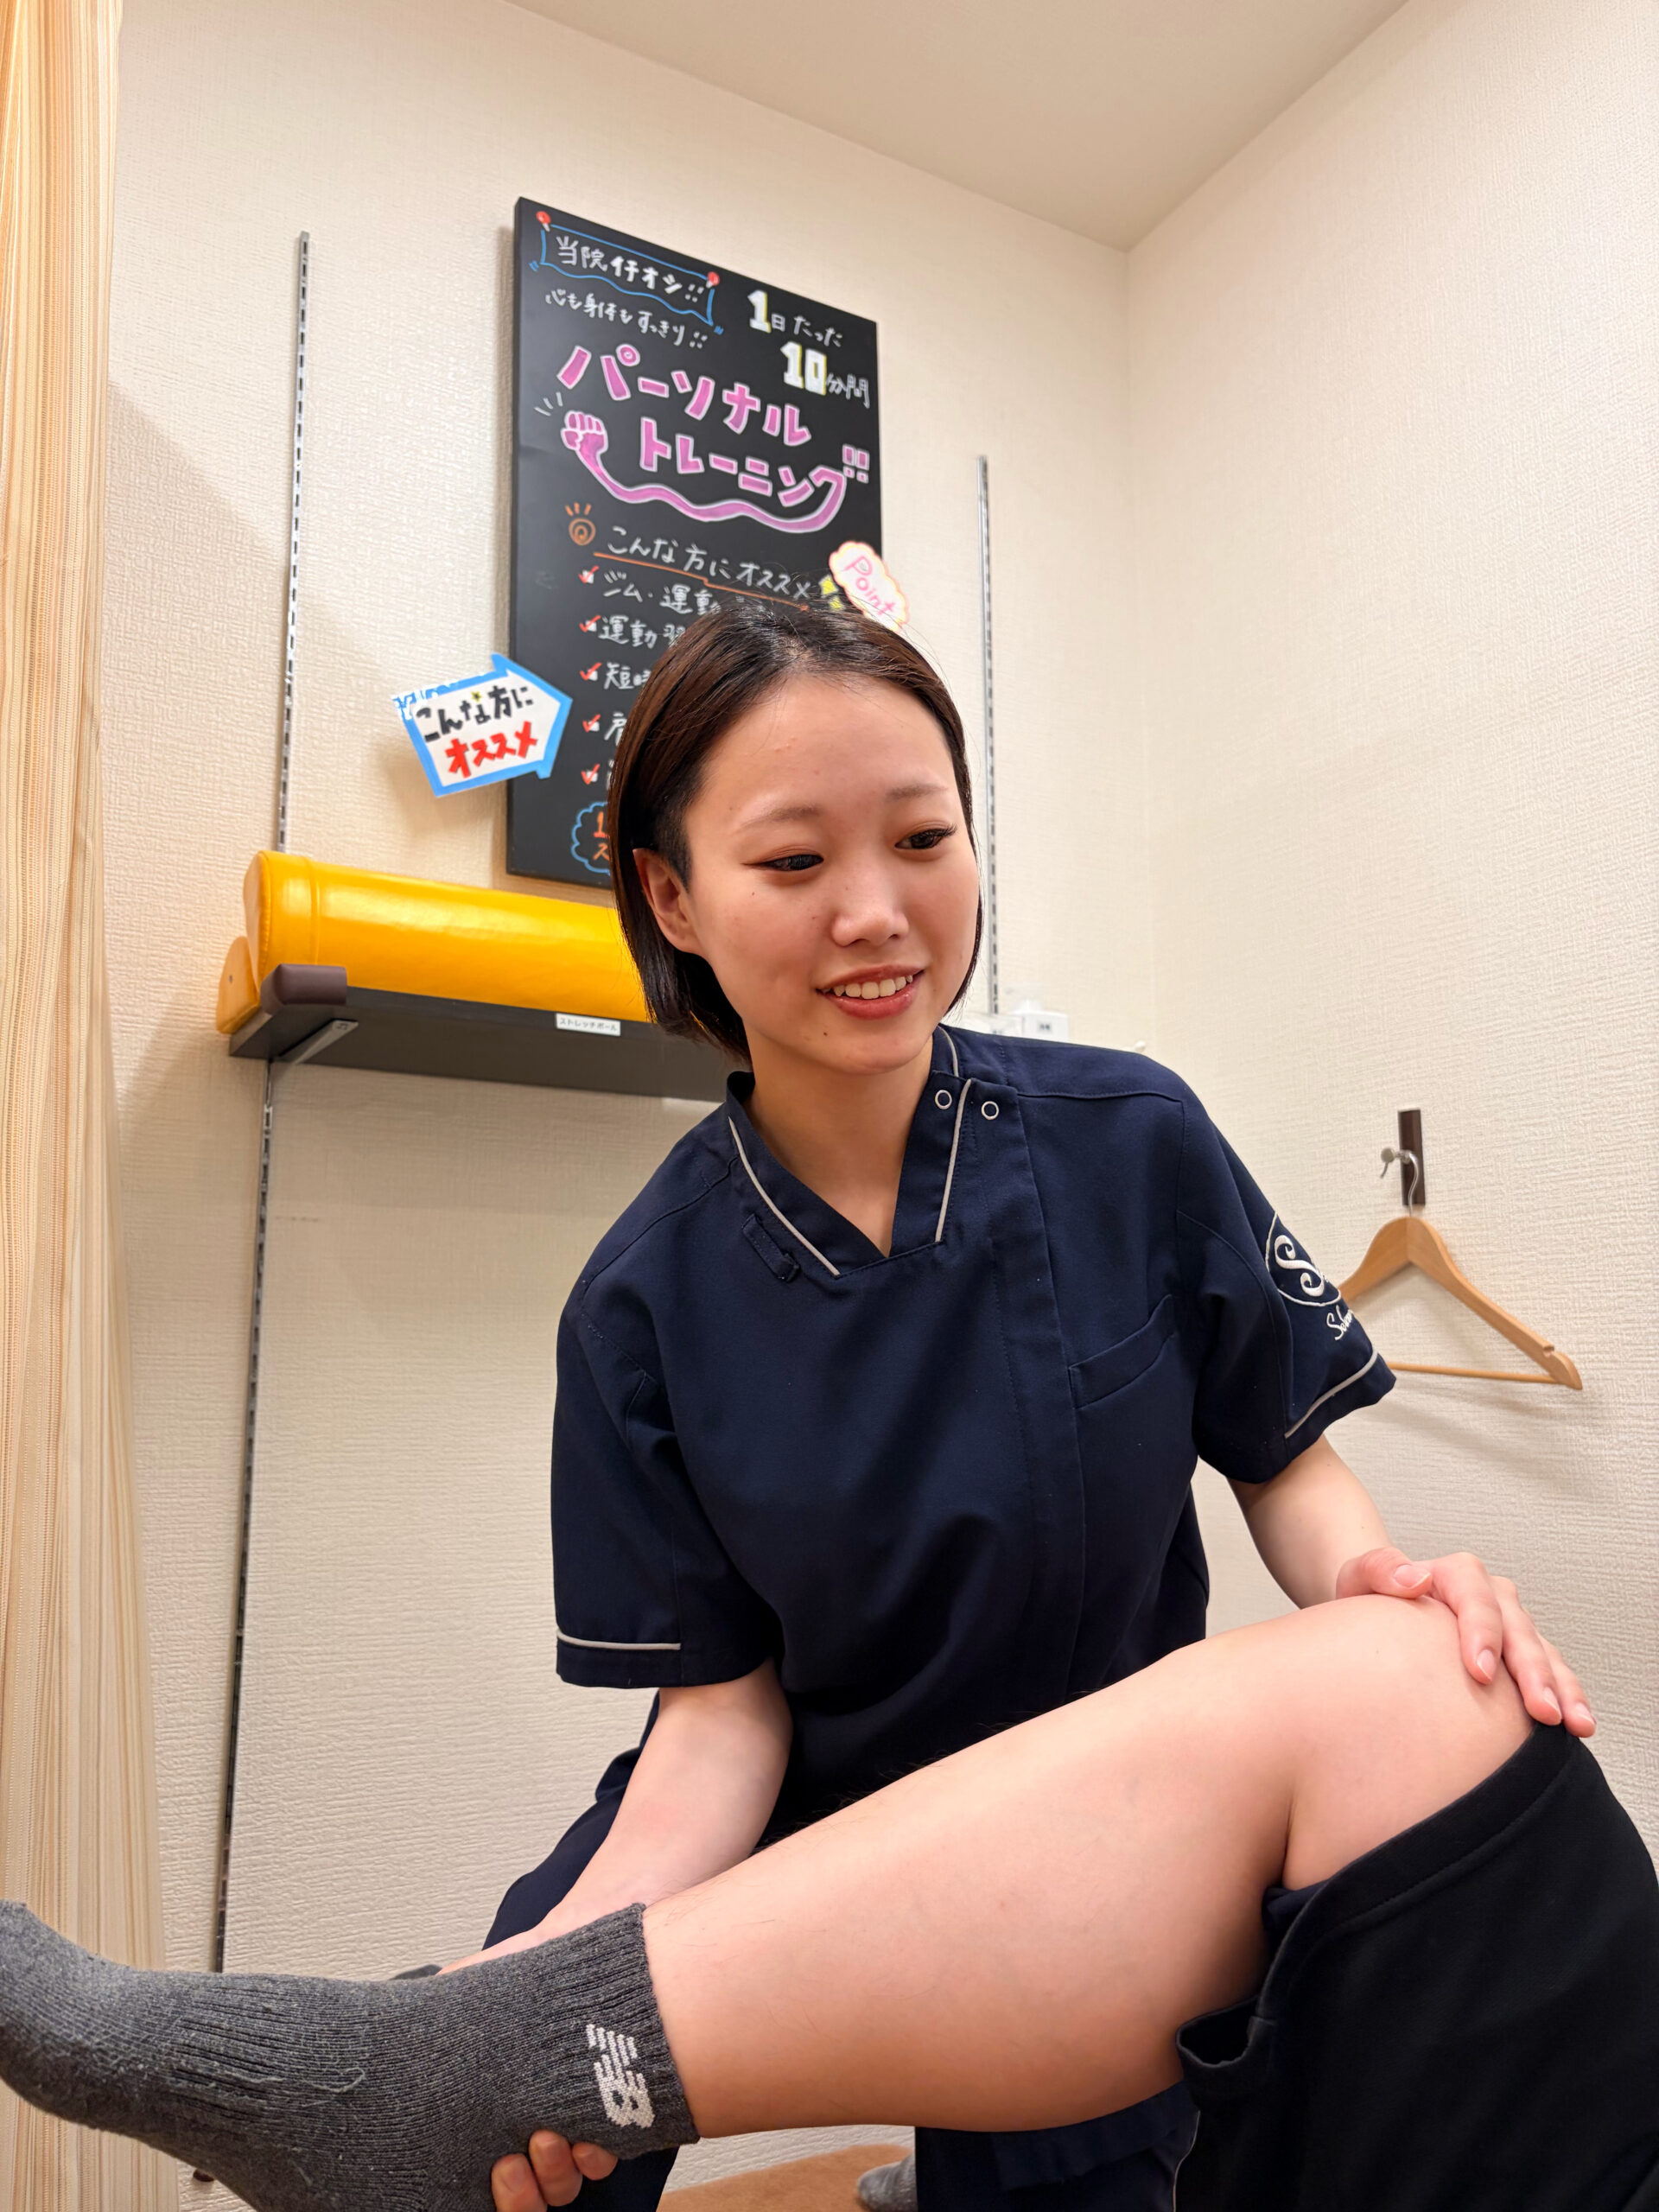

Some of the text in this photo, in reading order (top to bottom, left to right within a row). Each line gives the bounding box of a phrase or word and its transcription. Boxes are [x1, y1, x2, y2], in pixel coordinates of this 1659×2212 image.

[556, 344, 812, 447] パーソナル
[780, 341, 871, 410] 10分間
[607, 525, 811, 600] こんな方にオススメ
[844, 555, 896, 617] Point
[416, 684, 534, 743] こんな方に
[445, 720, 538, 779] オススメ
